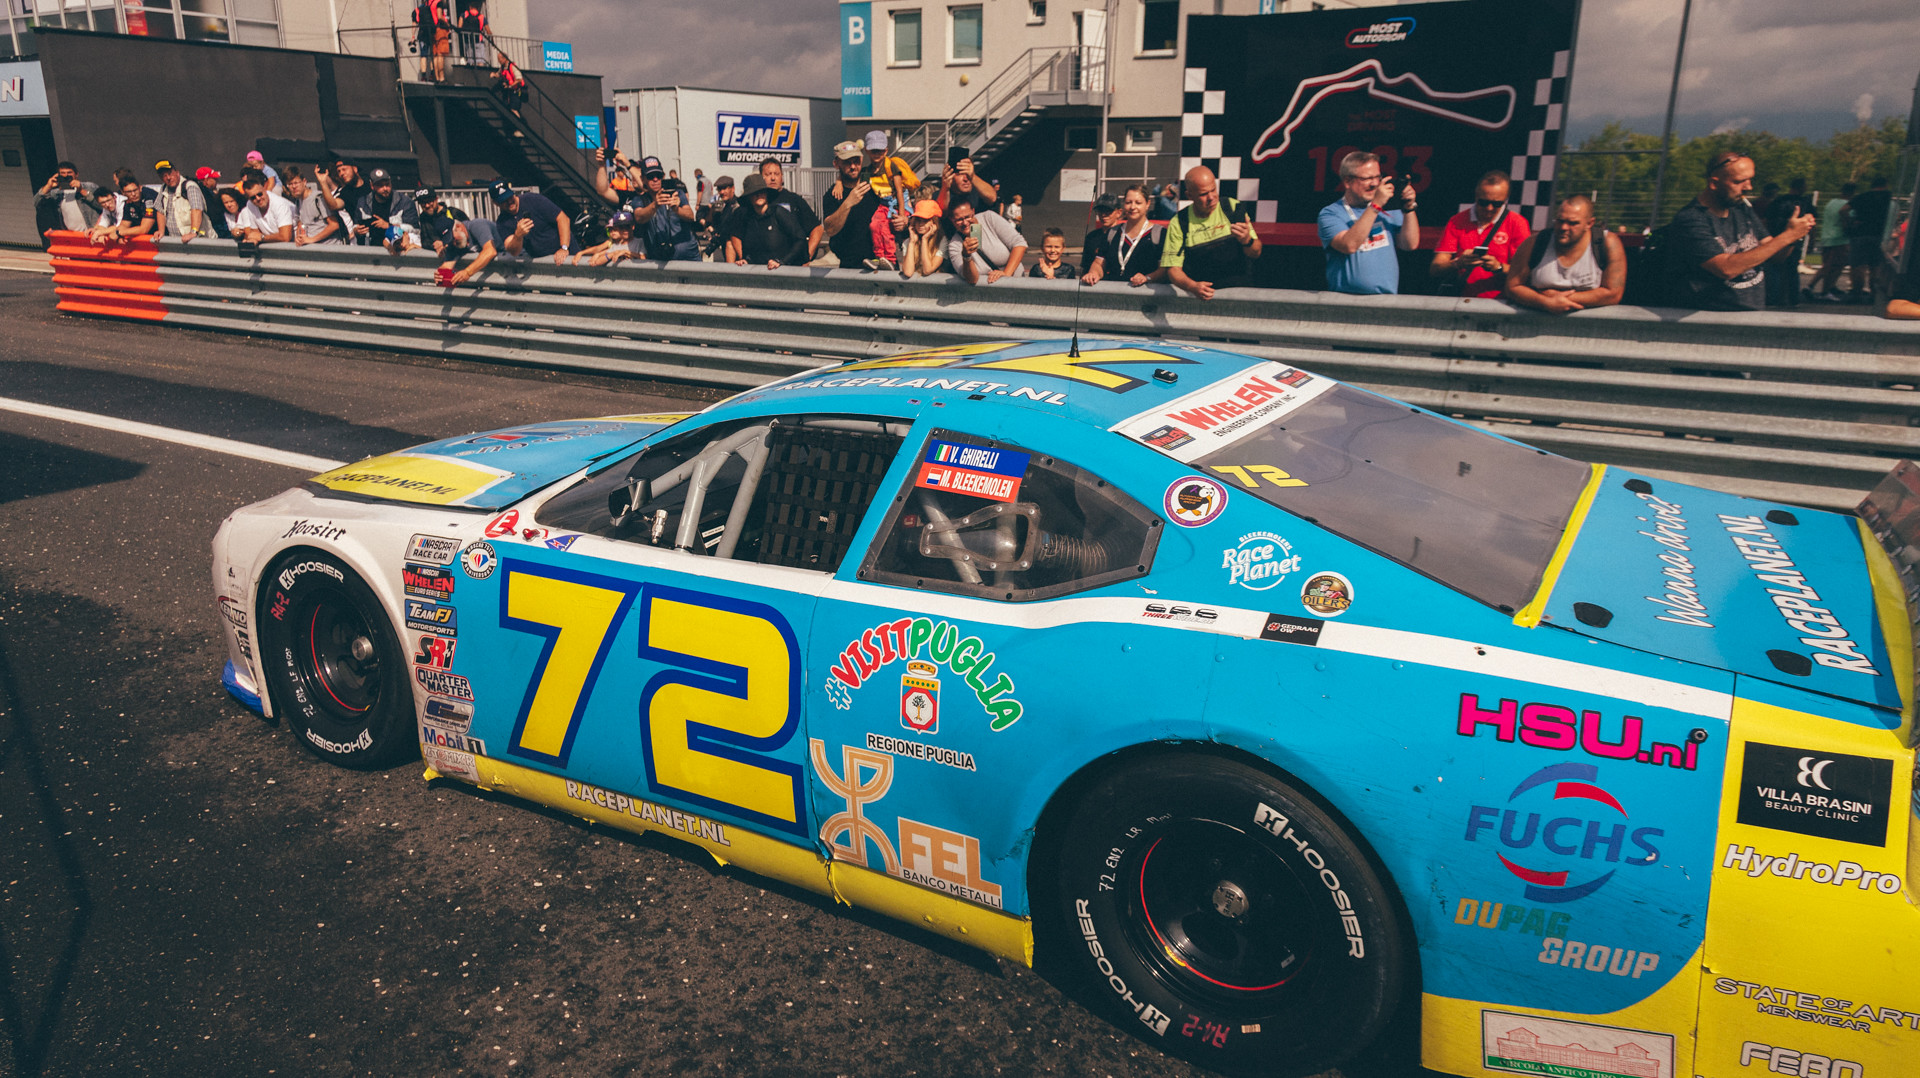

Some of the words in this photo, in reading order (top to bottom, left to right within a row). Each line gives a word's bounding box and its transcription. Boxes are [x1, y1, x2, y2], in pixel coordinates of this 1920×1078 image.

[848, 16, 865, 45] B
[1352, 32, 1407, 44] AUTODROM
[1368, 22, 1402, 34] MOST
[545, 60, 572, 70] CENTER
[546, 50, 569, 60] MEDIA
[843, 86, 871, 95] OFFICES
[775, 377, 1067, 406] RACEPLANET.NL
[1166, 374, 1285, 431] WHELEN
[1212, 414, 1258, 437] ENGINEERING
[1254, 400, 1285, 417] COMPANY
[949, 446, 959, 463] V.
[960, 447, 1000, 470] GHIRELLI
[939, 470, 952, 488] M.
[951, 471, 1014, 499] BLEEKEMOLEN
[1209, 464, 1310, 488] 72
[282, 519, 347, 541] Hoosier
[413, 549, 433, 559] RACE
[433, 551, 448, 561] CAR
[424, 539, 453, 552] NASCAR
[1221, 544, 1275, 568] Race
[289, 561, 344, 584] HOOSIER
[402, 569, 455, 593] WHELEN
[1229, 554, 1302, 585] Planet
[1716, 513, 1882, 676] RACEPLANET.NL
[407, 621, 455, 636] MOTORSPORTS
[417, 668, 468, 688] QUARTER
[427, 679, 472, 699] MASTER
[825, 617, 1023, 732] #VISITPUGLIA
[499, 557, 810, 839] 72
[306, 727, 360, 754] HOOSIER
[423, 726, 465, 751] Mobil
[866, 732, 923, 759] REGIONE
[925, 746, 976, 771] PUGLIA
[565, 778, 731, 847] RACEPLANET.NL
[1756, 785, 1802, 803] VILLA
[1806, 794, 1872, 815] BRASINI
[1765, 800, 1811, 815] BEAUTY
[1815, 809, 1860, 823] CLINIC
[1464, 804, 1665, 866] FUCHS
[898, 816, 1001, 895] FEL
[1099, 872, 1116, 891] 72
[1125, 826, 1143, 838] LR
[1722, 843, 1901, 895] HydroPro
[902, 869, 946, 890] BANCO
[949, 885, 1002, 909] METALLI
[1283, 827, 1365, 959] HOOSIER
[1454, 897, 1572, 938] DUPAG
[1075, 898, 1144, 1014] HOOSIER
[1538, 936, 1660, 979] GROUP
[1713, 977, 1820, 1011] STATE
[1821, 997, 1853, 1011] OF
[1852, 1003, 1920, 1031] ART
[1757, 1002, 1871, 1034] MENSWEAR
[1548, 1066, 1587, 1077] ANTICO
